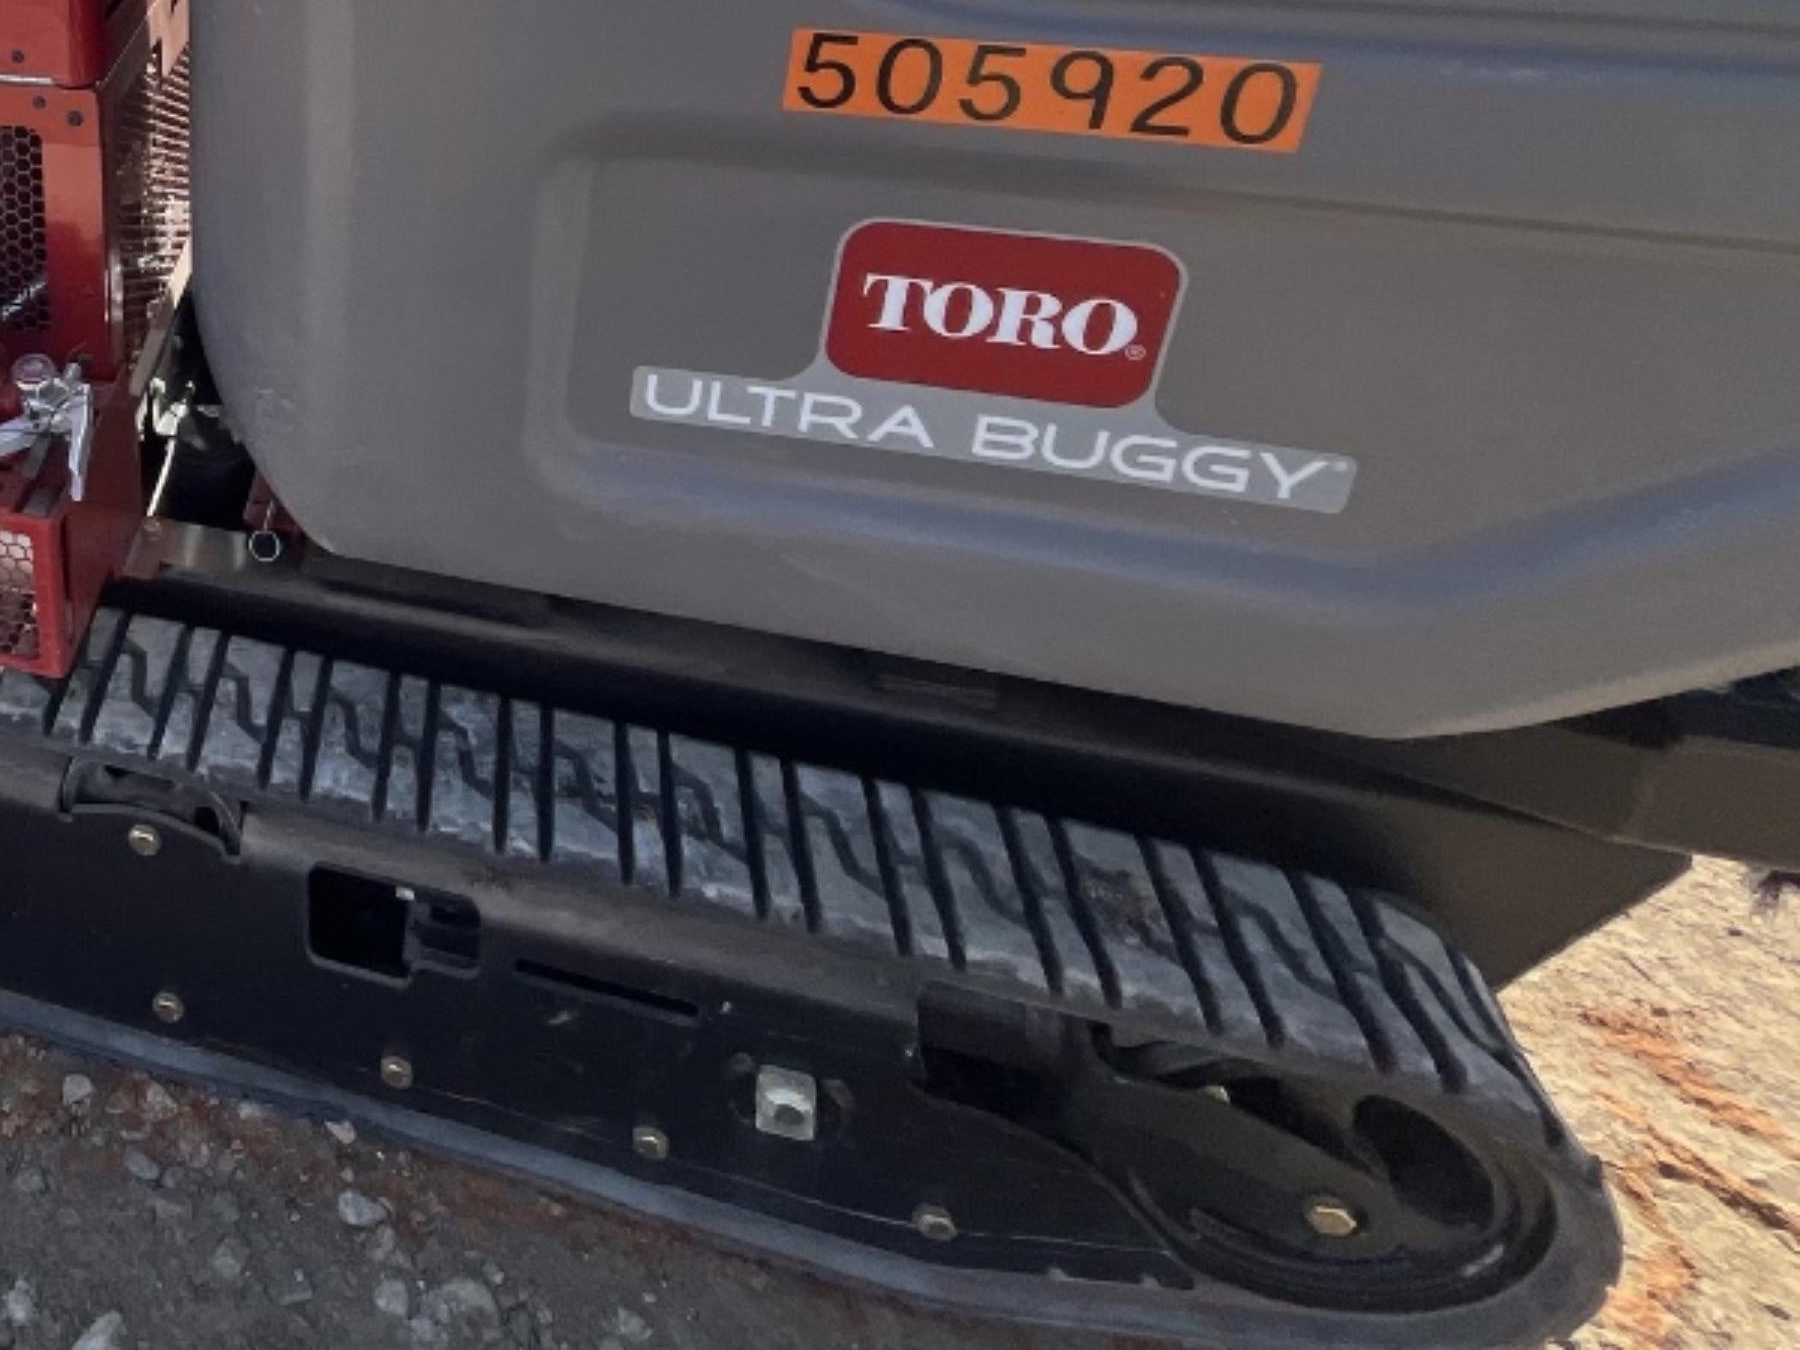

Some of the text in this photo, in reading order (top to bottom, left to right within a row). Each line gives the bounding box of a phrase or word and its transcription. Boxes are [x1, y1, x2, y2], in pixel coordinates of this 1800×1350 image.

[797, 32, 1298, 145] 505920
[863, 273, 1139, 356] TORO
[644, 373, 1331, 500] ULTRA BUGGY
